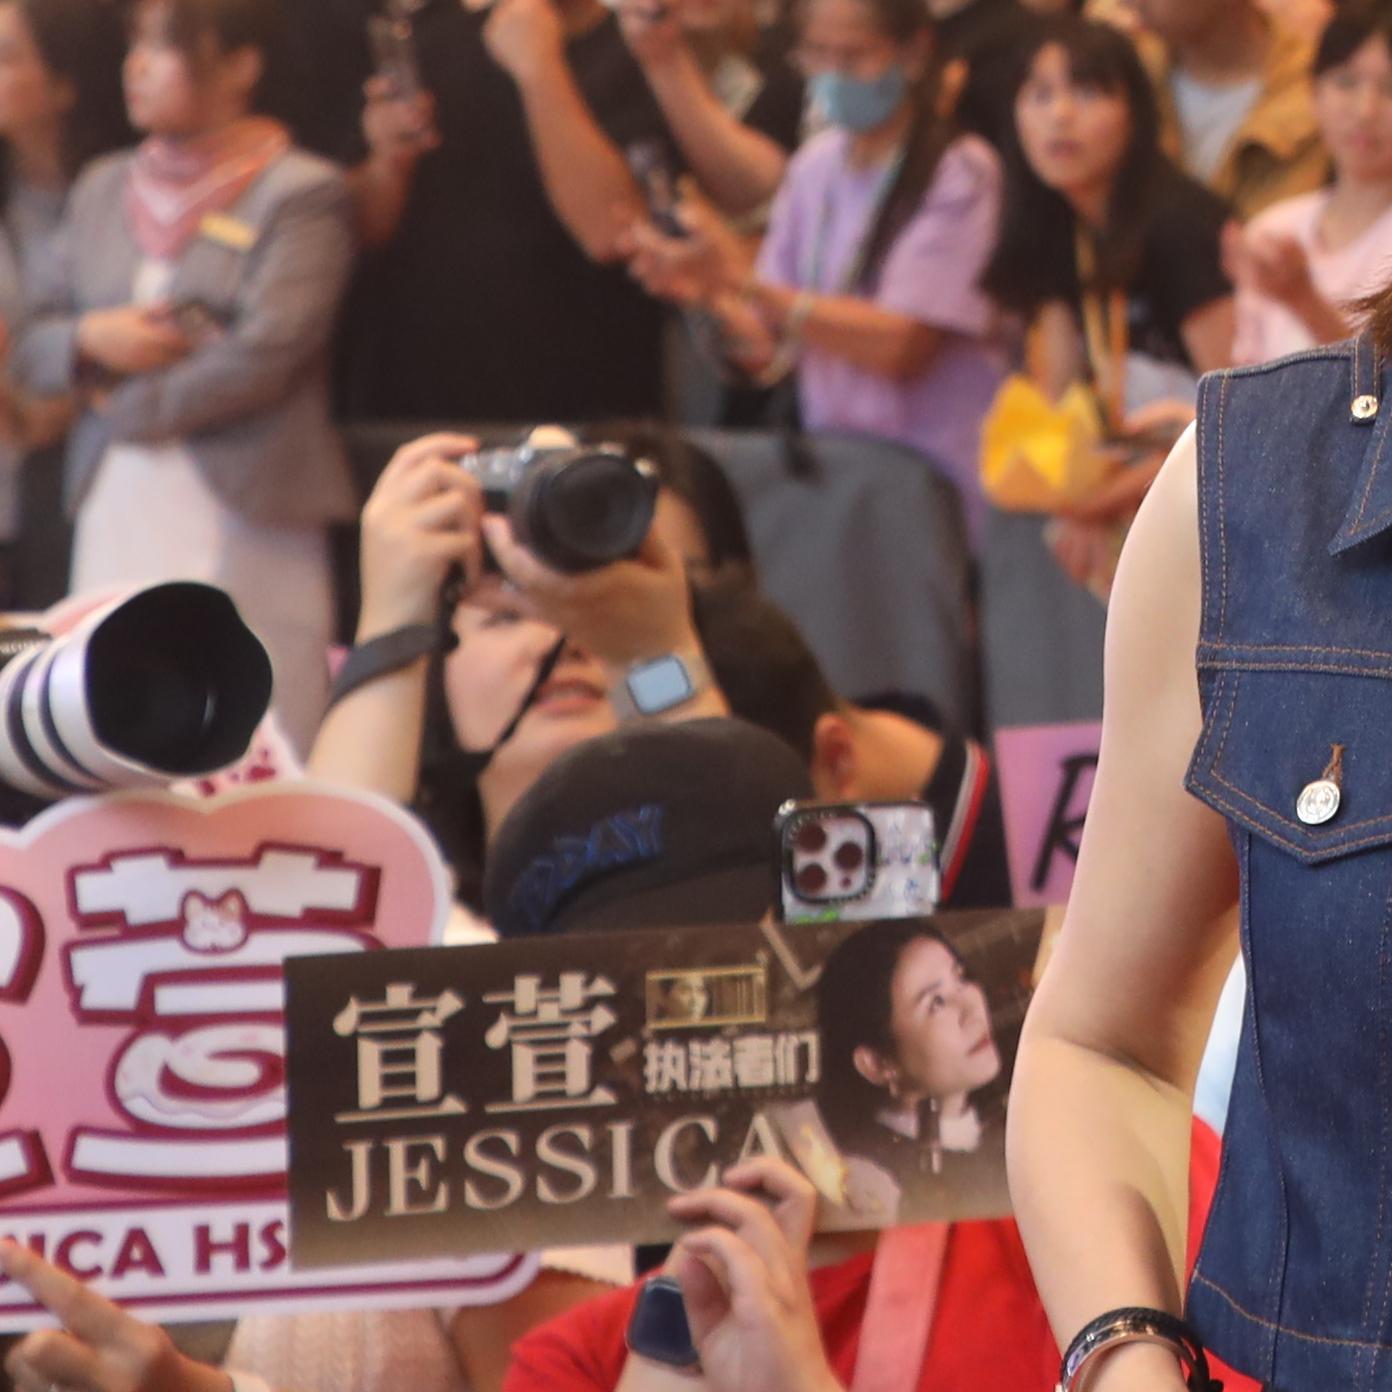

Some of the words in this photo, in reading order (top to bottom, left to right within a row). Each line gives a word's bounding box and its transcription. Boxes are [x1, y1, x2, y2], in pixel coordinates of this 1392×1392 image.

[332, 971, 618, 1123] 宣萱
[644, 1030, 821, 1094] 执法者们
